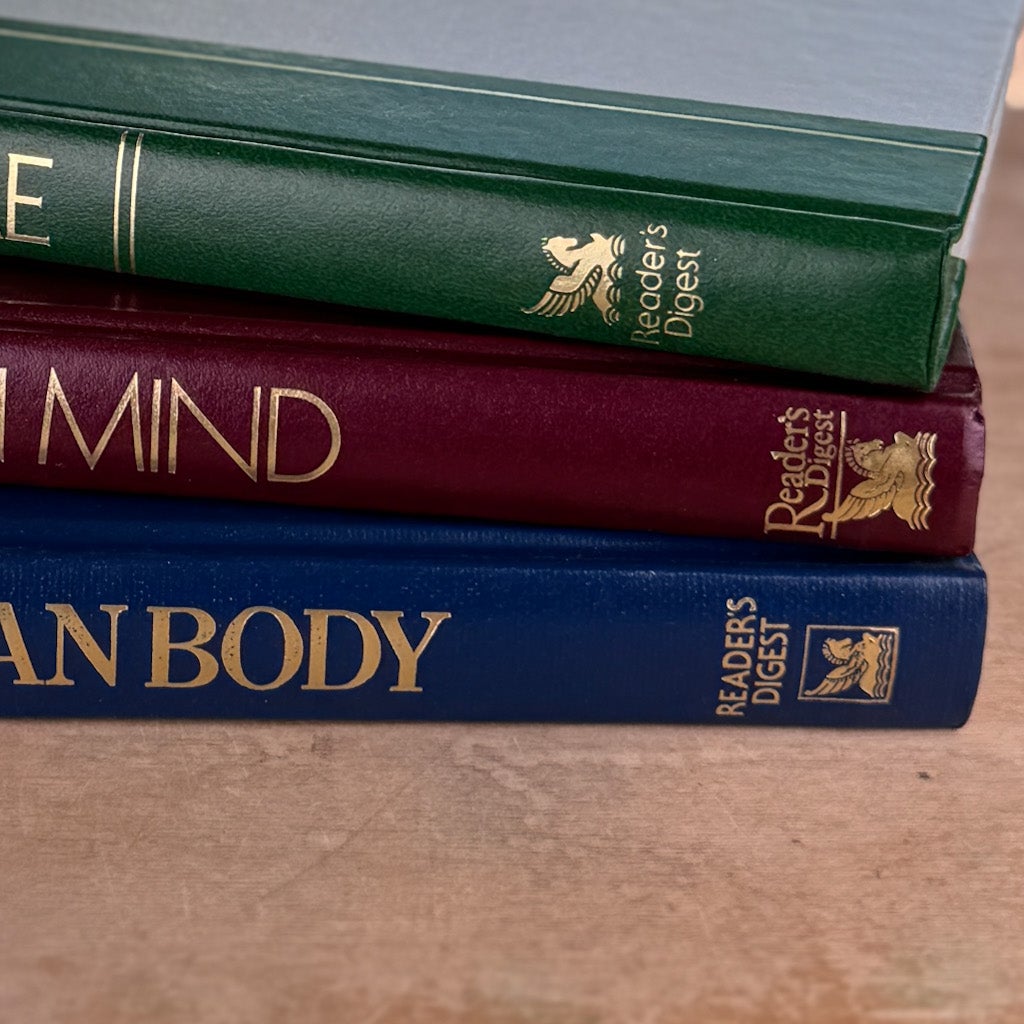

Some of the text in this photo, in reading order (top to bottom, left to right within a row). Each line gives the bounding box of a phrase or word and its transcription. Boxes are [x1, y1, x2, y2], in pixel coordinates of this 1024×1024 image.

[630, 223, 668, 345] Reader's
[664, 249, 704, 338] Digest
[38, 366, 342, 483] MIND
[764, 407, 825, 539] Reader's
[803, 409, 835, 490] Digest
[145, 605, 452, 692] BODY
[716, 596, 757, 717] READER'S
[751, 617, 791, 706] DIGEST
